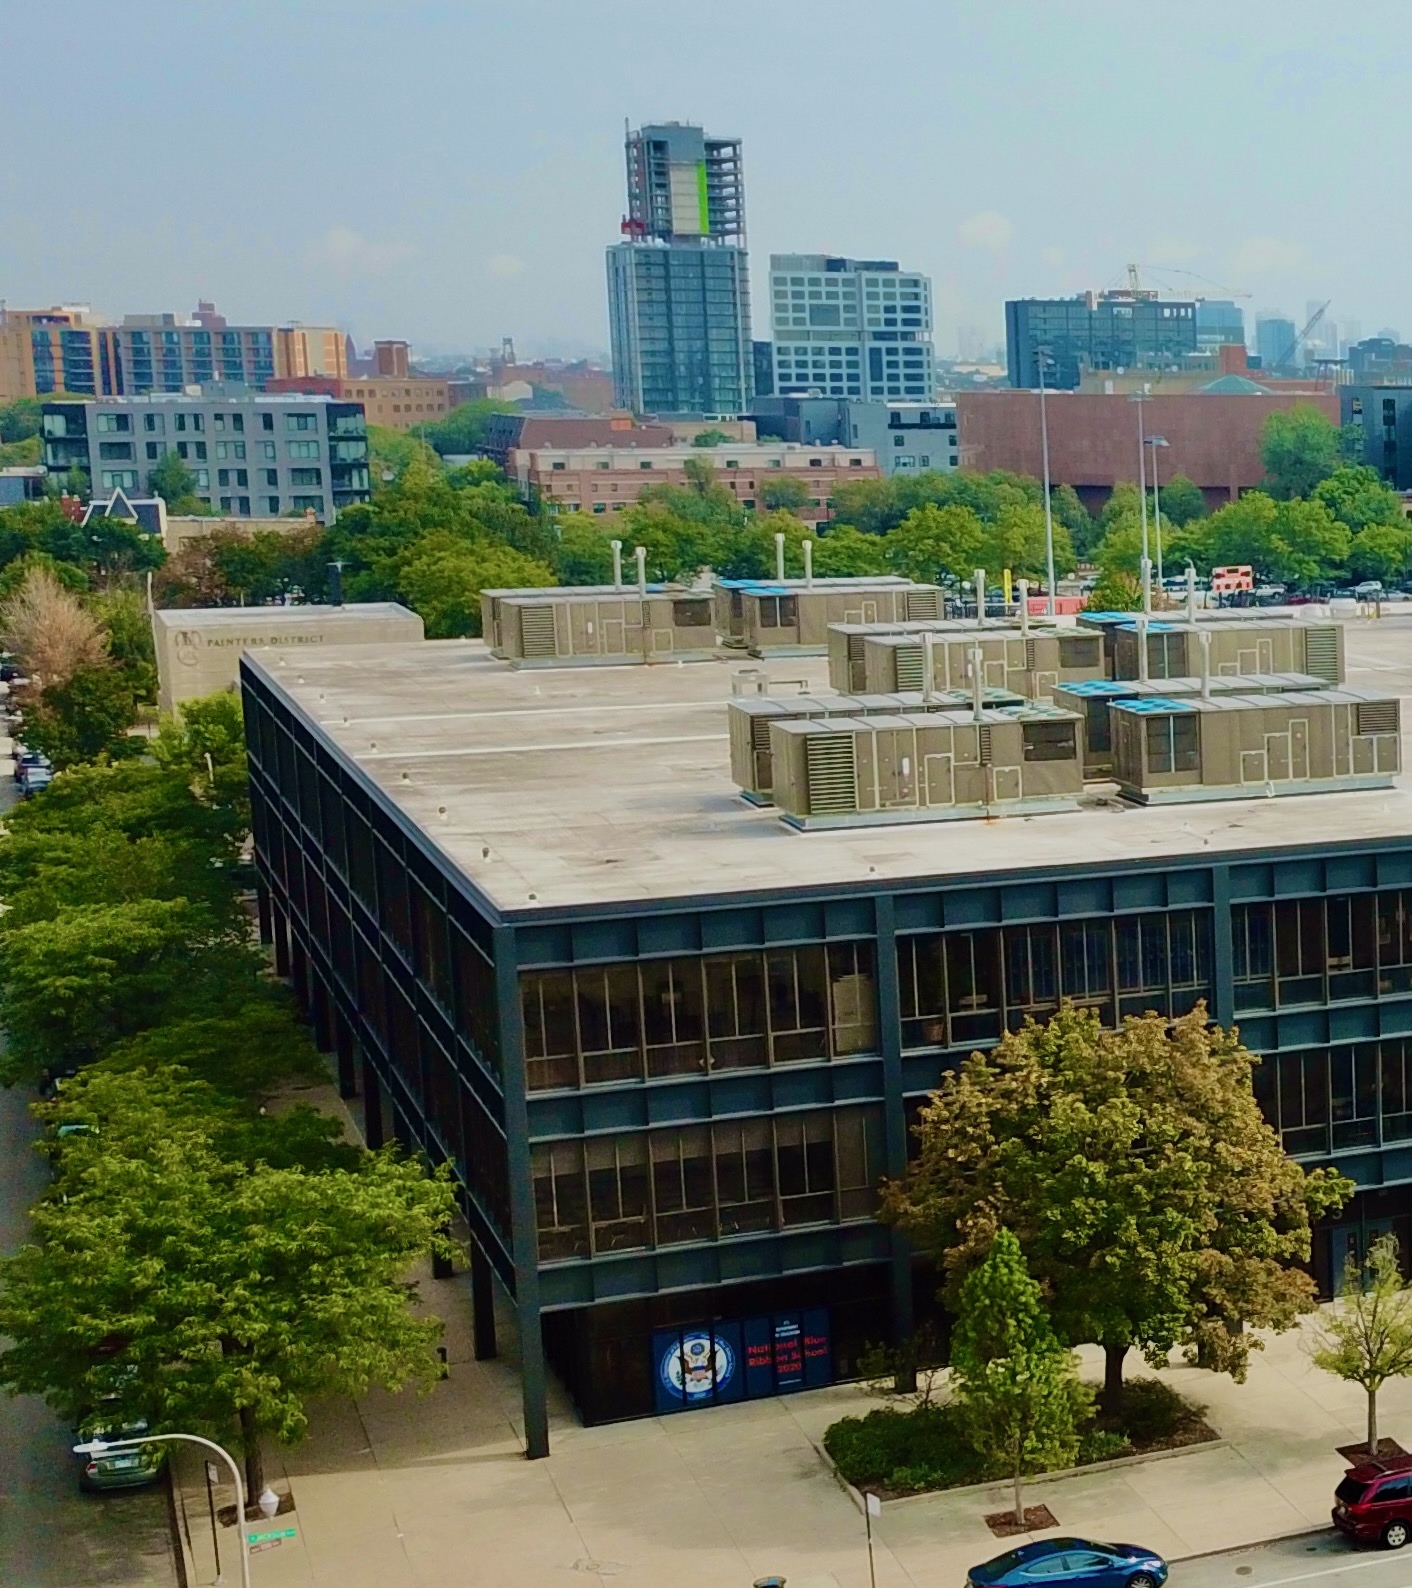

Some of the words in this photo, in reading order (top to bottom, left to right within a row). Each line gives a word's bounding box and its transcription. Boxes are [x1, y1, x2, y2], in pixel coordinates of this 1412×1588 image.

[208, 638, 264, 647] PAINTERS
[271, 635, 324, 645] DISTRICT
[778, 1362, 801, 1373] 2020
